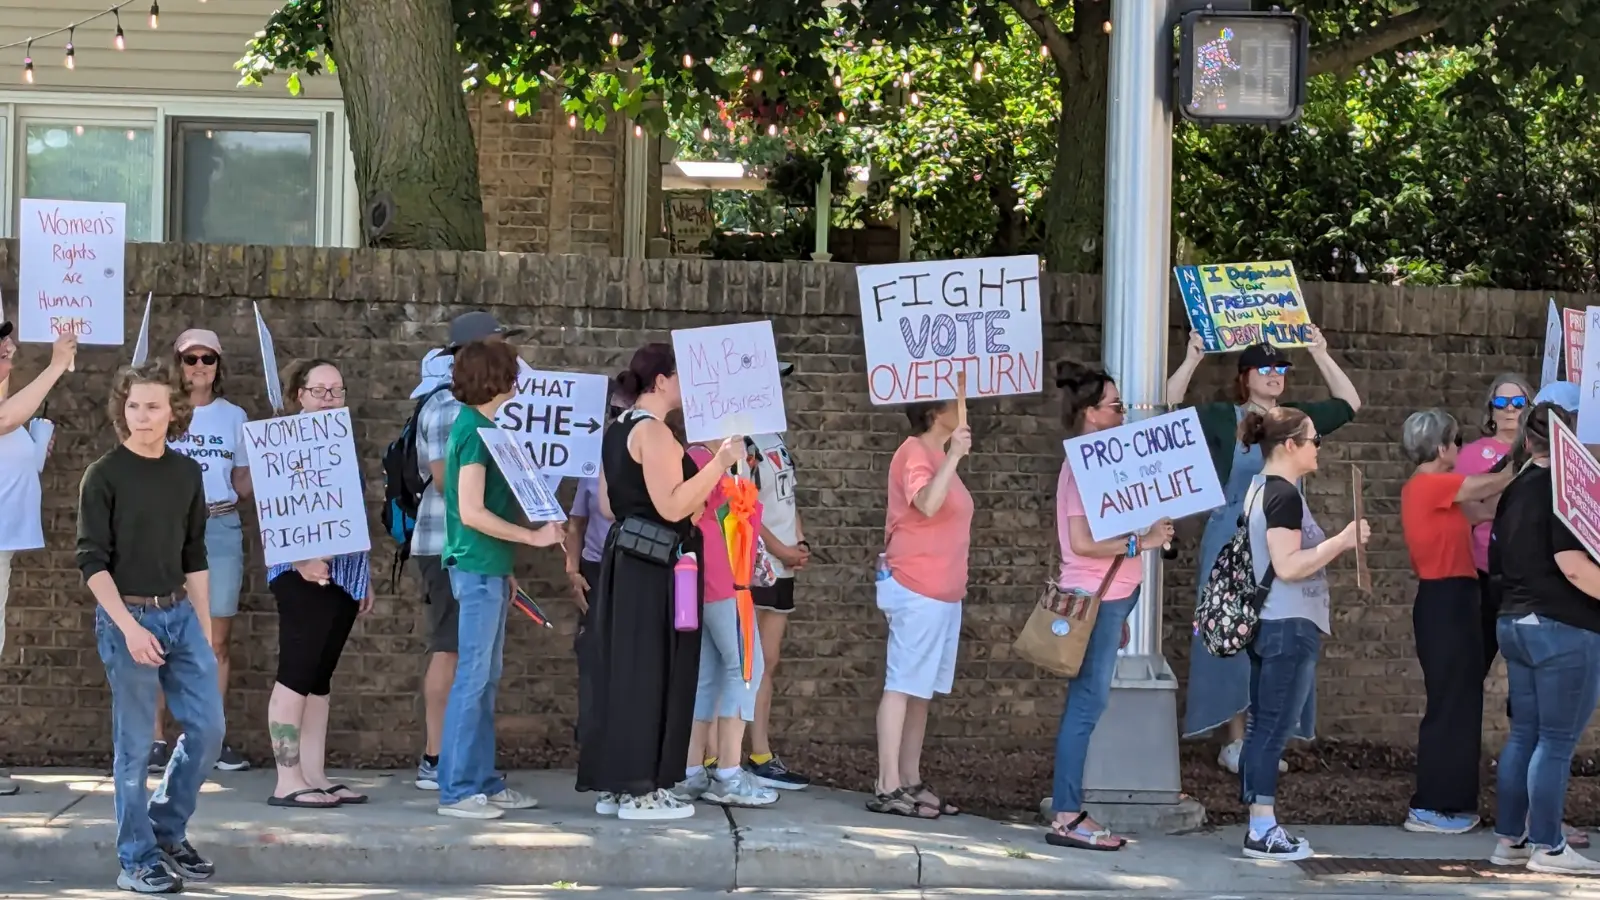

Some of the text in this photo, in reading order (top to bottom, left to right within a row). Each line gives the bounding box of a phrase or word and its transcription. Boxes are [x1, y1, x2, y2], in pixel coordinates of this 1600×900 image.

[38, 206, 115, 235] Women's
[52, 241, 97, 269] Rights
[62, 272, 83, 285] Are
[1203, 263, 1292, 282] I Defended
[37, 290, 93, 309] Human
[872, 267, 1038, 322] FIGHT
[1183, 269, 1215, 350] NAVY VET
[1210, 290, 1299, 314] FREEDOM
[50, 316, 93, 336] Rights
[1224, 307, 1282, 324] Now You
[899, 310, 1011, 359] VOTE
[1217, 321, 1313, 349] DENY MINE
[688, 337, 768, 388] My Bdy
[870, 351, 1039, 401] OVERTURN
[245, 411, 349, 449] WOMEN'S
[501, 402, 574, 436] SHE
[209, 435, 224, 445] as
[1080, 417, 1196, 470] PRO-CHOICE
[264, 444, 343, 479] RIGHTS
[1139, 460, 1163, 478] not
[287, 468, 333, 492] ARE
[1100, 465, 1203, 518] ANTI-LIFE
[1566, 471, 1600, 517] PLANNE
[258, 491, 343, 521] HUMAN
[261, 519, 352, 550] RIGHTS
